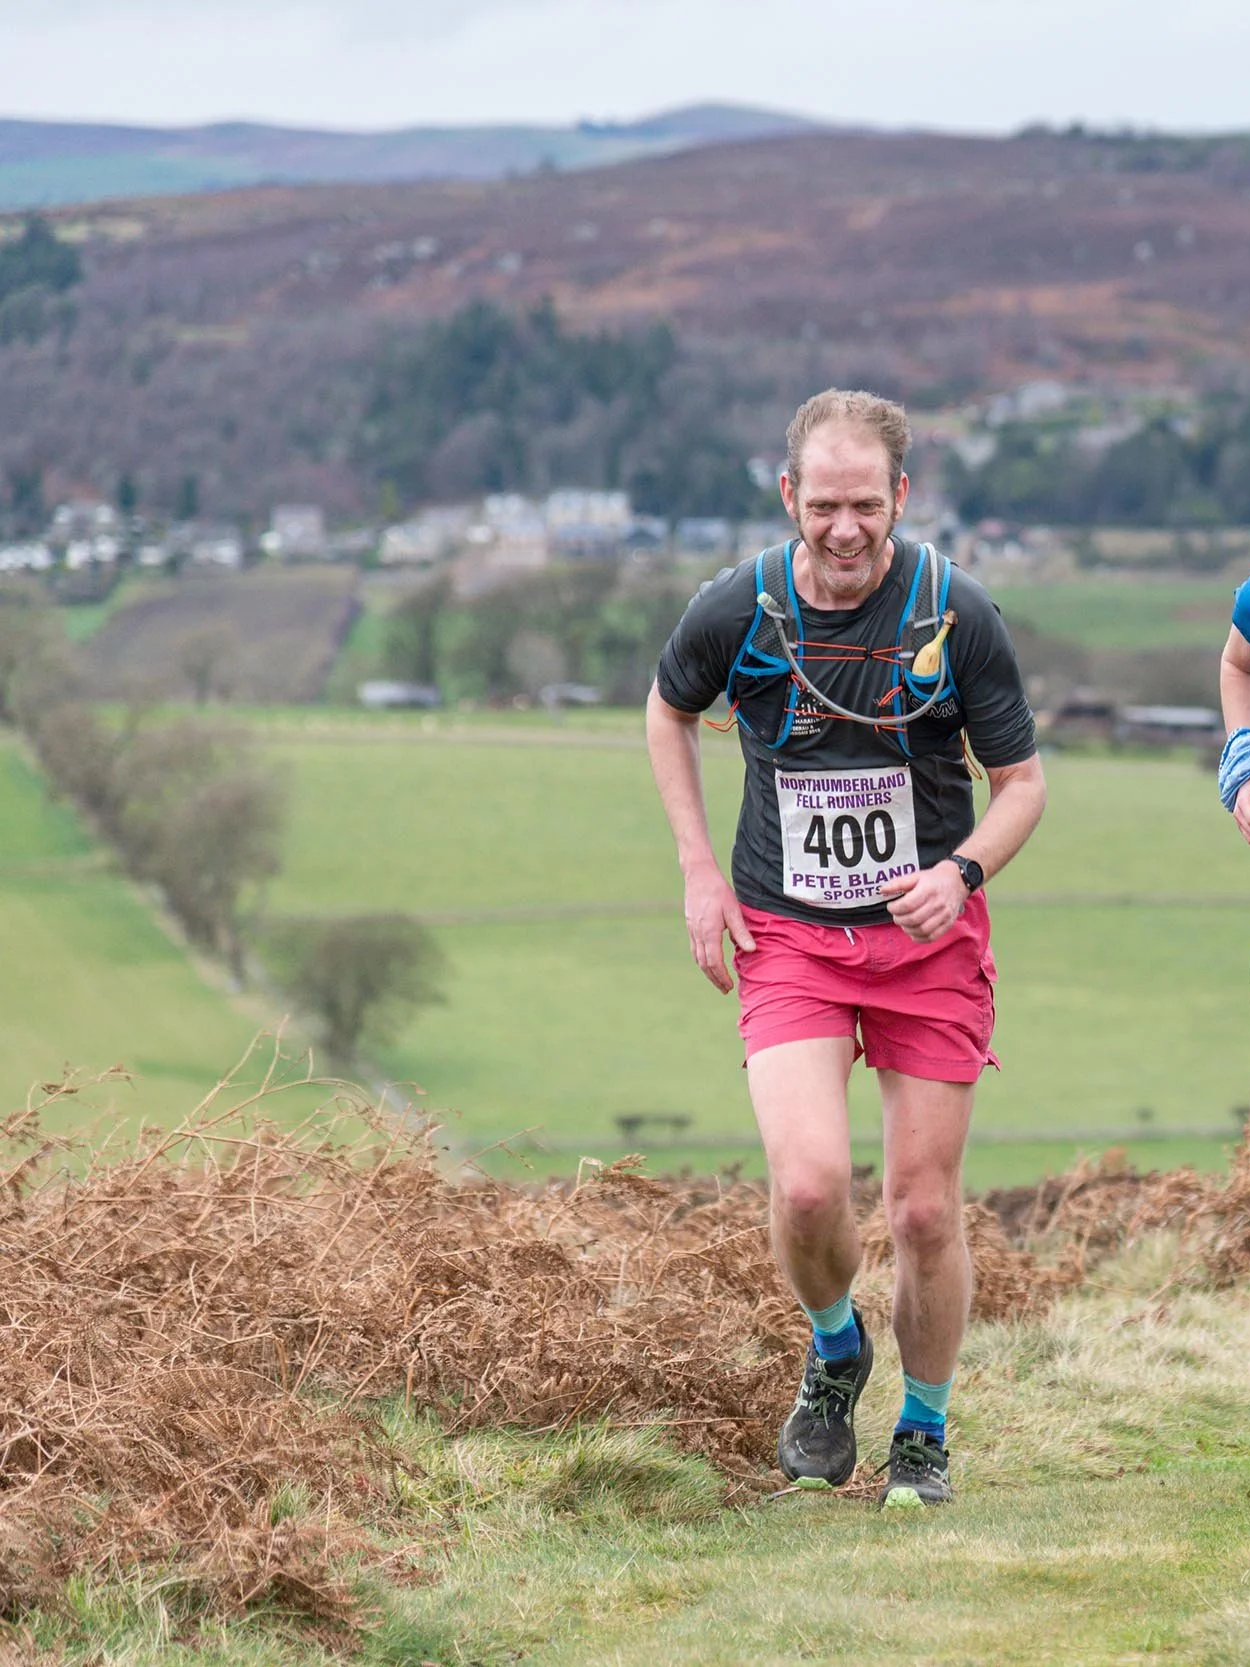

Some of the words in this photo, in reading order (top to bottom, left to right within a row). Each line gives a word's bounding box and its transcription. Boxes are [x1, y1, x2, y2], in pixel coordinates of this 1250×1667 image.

[780, 773, 906, 792] NORTHUMBERLAND
[796, 793, 823, 808] FELL
[828, 792, 892, 808] RUNNERS
[803, 809, 897, 868] 400
[792, 873, 841, 888] PETE
[848, 863, 916, 887] BLAND
